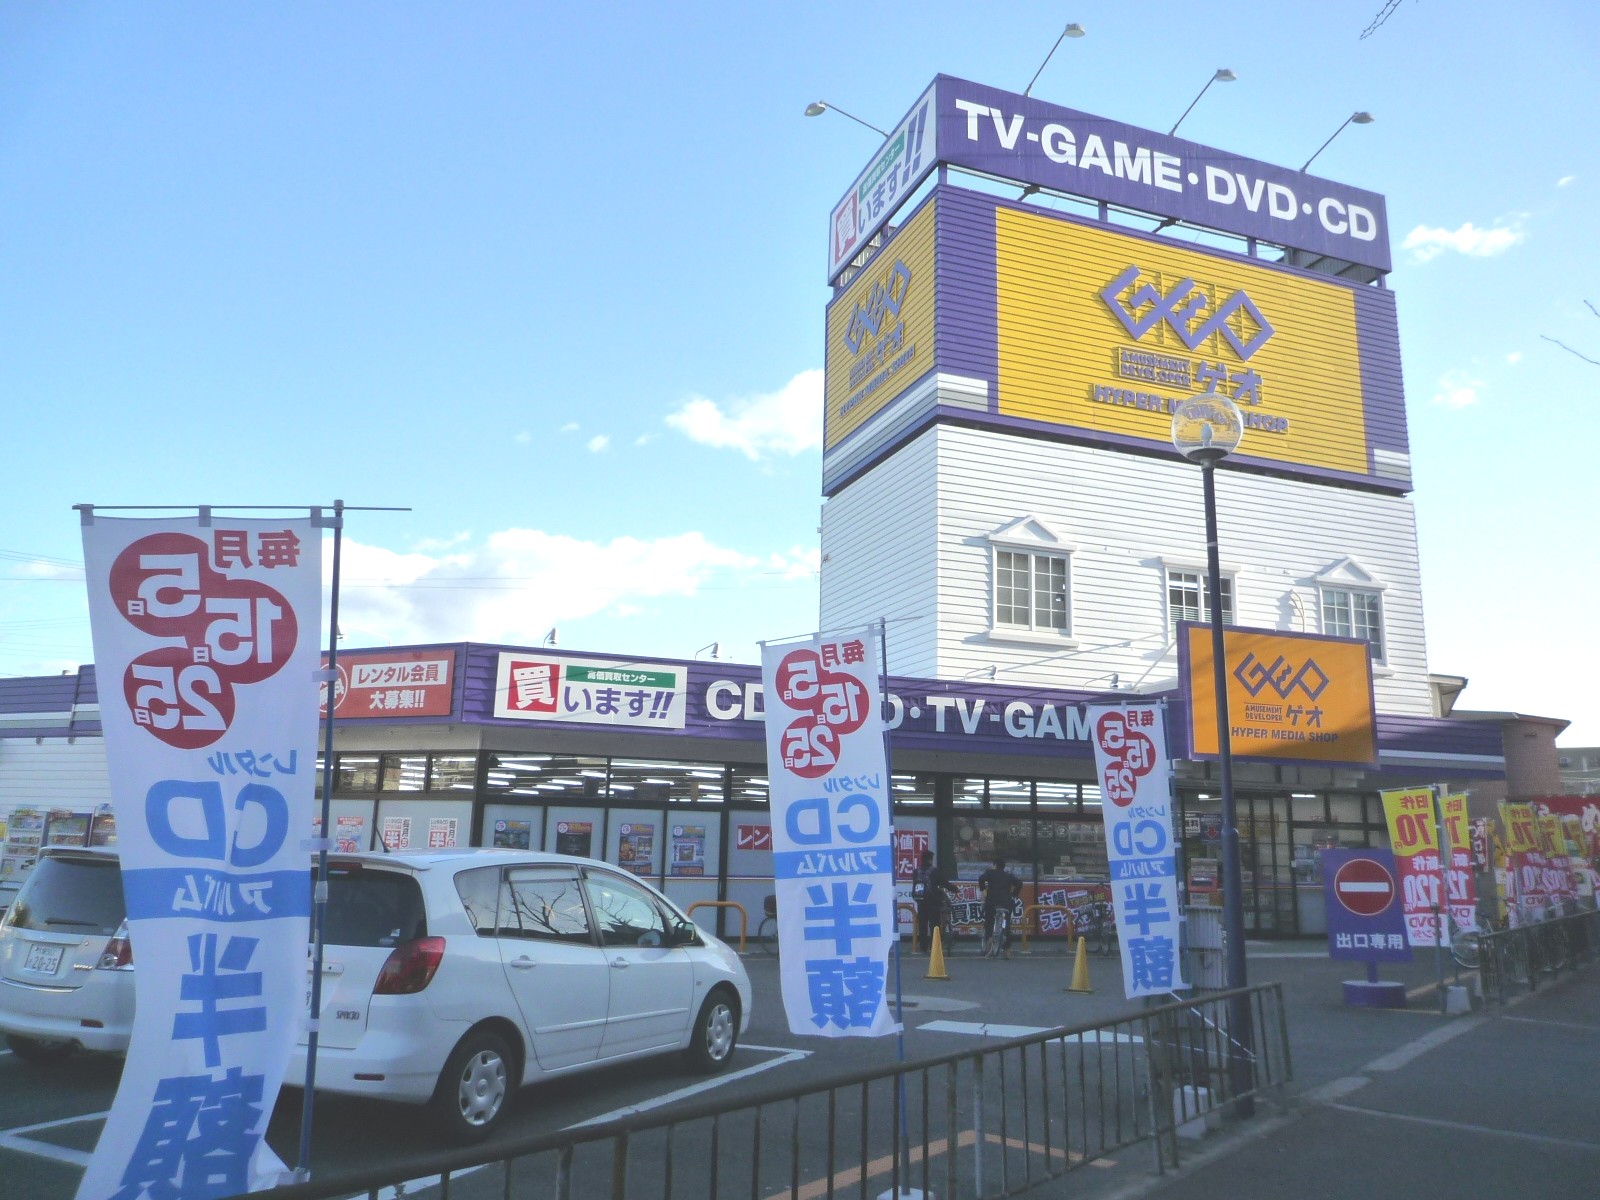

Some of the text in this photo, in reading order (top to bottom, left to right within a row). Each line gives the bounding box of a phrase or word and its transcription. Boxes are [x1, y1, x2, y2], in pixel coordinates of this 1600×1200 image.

[955, 98, 1377, 242] TV-GAME DVD CD
[1121, 350, 1190, 372] AMUSEMENT
[1121, 363, 1190, 385] DEVELOPER
[1195, 360, 1263, 406] ゲオ
[1094, 383, 1162, 412] HYPER
[357, 663, 439, 683] レンタル会員
[587, 670, 656, 683] 高価買取センター
[1233, 651, 1330, 702] GEO
[369, 689, 425, 710] 大募集!!
[513, 665, 675, 720] 買 います!!
[926, 696, 1093, 741] TV-GAM
[1245, 704, 1282, 714] AMUSEMENT
[1245, 712, 1283, 722] DEVELOPER
[1285, 703, 1323, 728] ゲオ
[1231, 726, 1339, 743] HYPER MEDIA SHOP
[1336, 933, 1404, 949] 出口専用
